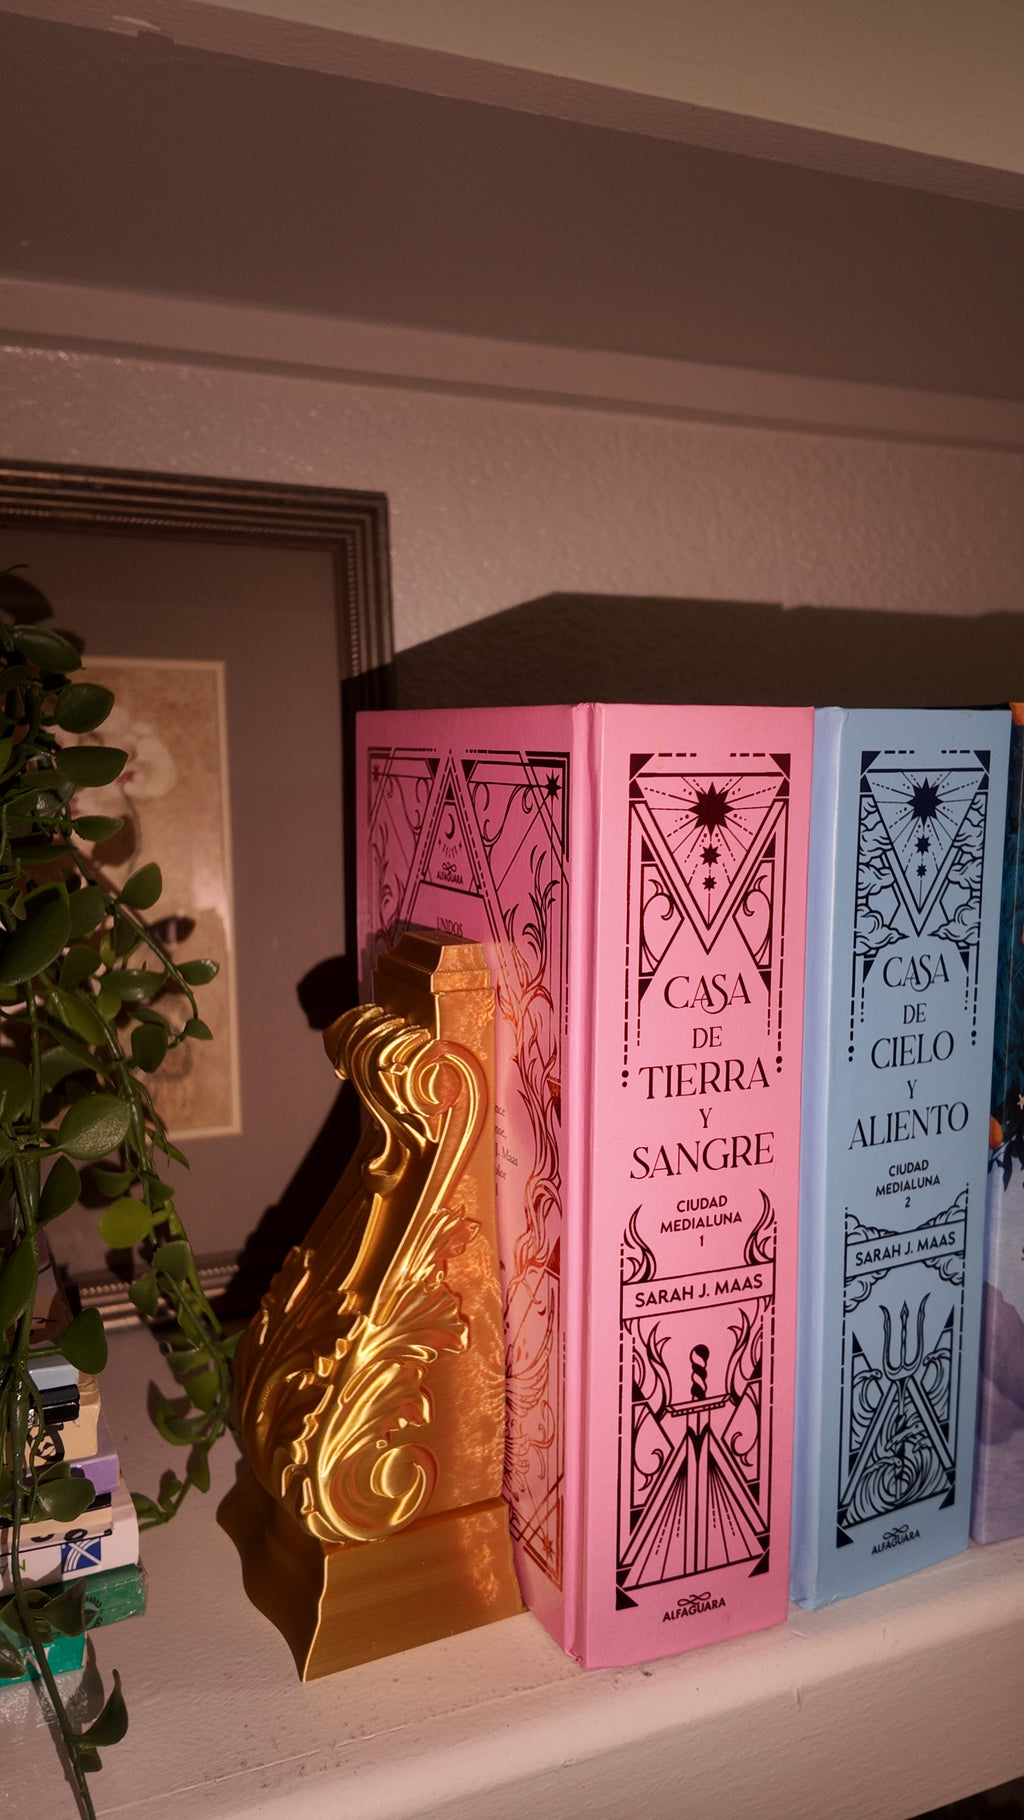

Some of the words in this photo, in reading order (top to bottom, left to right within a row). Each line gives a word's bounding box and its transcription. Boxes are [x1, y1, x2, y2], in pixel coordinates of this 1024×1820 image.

[883, 952, 950, 992] CASA
[663, 972, 752, 1015] CASA
[902, 1002, 927, 1025] DE
[692, 1025, 723, 1049] DE
[871, 1030, 954, 1070] CIELO
[638, 1056, 770, 1100] TIERRA
[907, 1079, 918, 1099] Y
[699, 1107, 713, 1129] Y
[848, 1101, 969, 1150] ALIENTO
[630, 1131, 775, 1180] SANGRE
[888, 1159, 929, 1177] CIUDAD
[875, 1174, 941, 1197] MEDIALUNA
[676, 1195, 728, 1213] CIUDAD
[904, 1196, 911, 1208] 2
[660, 1211, 743, 1234] MEDIALUNA
[699, 1234, 704, 1247] 1
[855, 1243, 901, 1267] SARAH
[904, 1241, 914, 1255] J.
[917, 1231, 956, 1252] MAAS
[635, 1285, 694, 1308] SARAH
[698, 1283, 710, 1298] J.
[714, 1273, 763, 1296] MAAS
[870, 1529, 921, 1555] ALFAGUARA
[662, 1597, 726, 1622] ALFAGUARA
